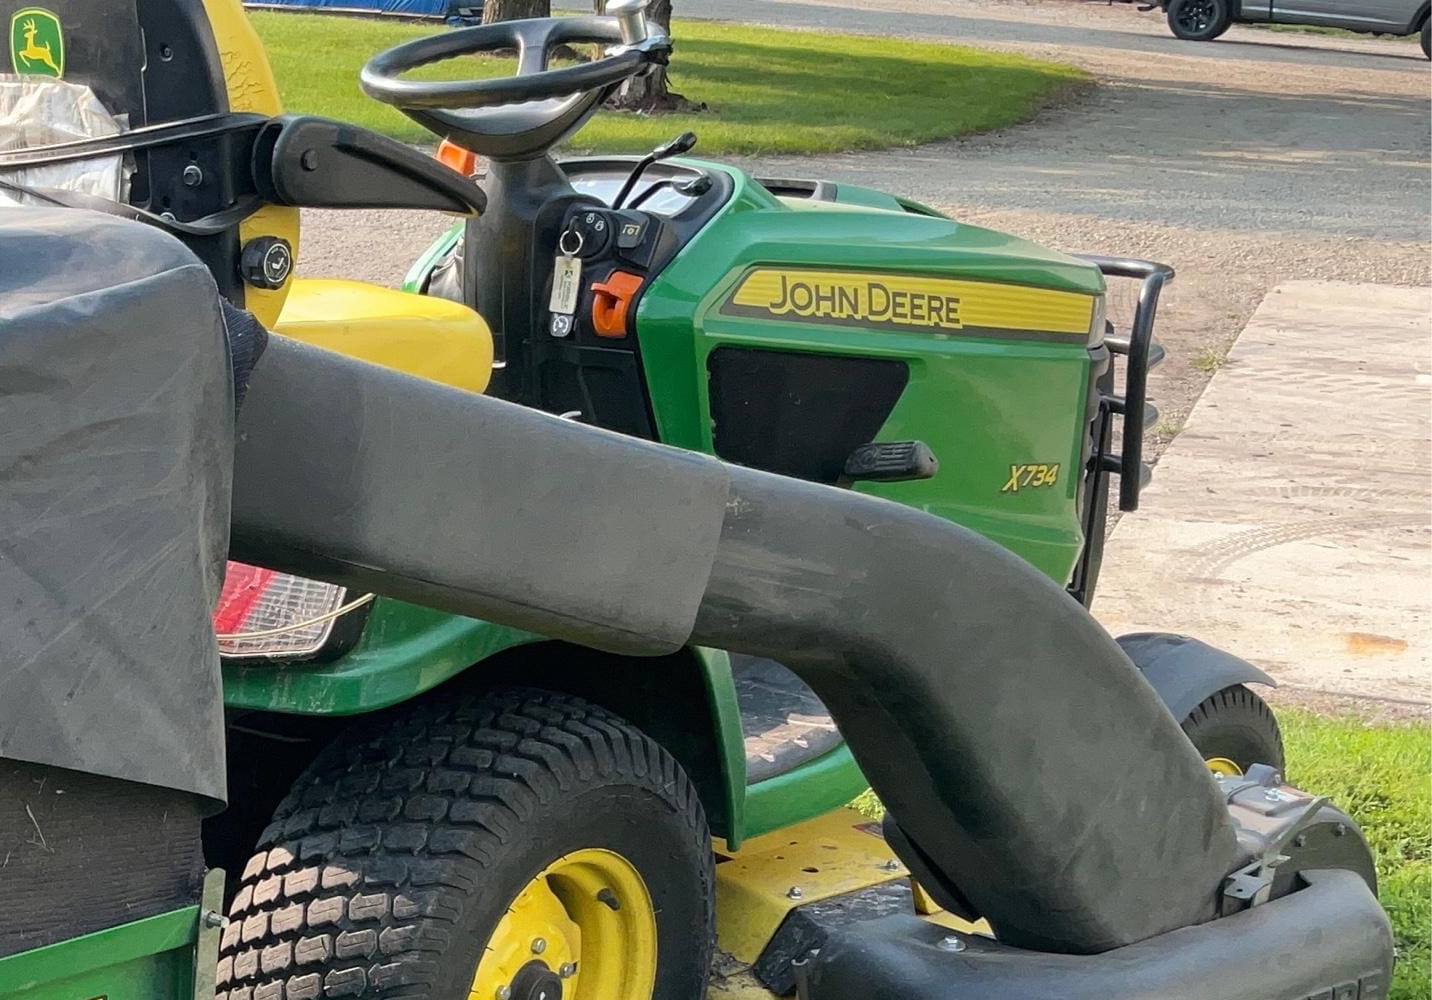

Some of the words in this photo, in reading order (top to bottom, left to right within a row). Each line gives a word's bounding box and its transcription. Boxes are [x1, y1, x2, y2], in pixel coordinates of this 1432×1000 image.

[769, 275, 860, 316] JOHN
[867, 282, 961, 325] DEERE
[1001, 463, 1059, 491] X734
